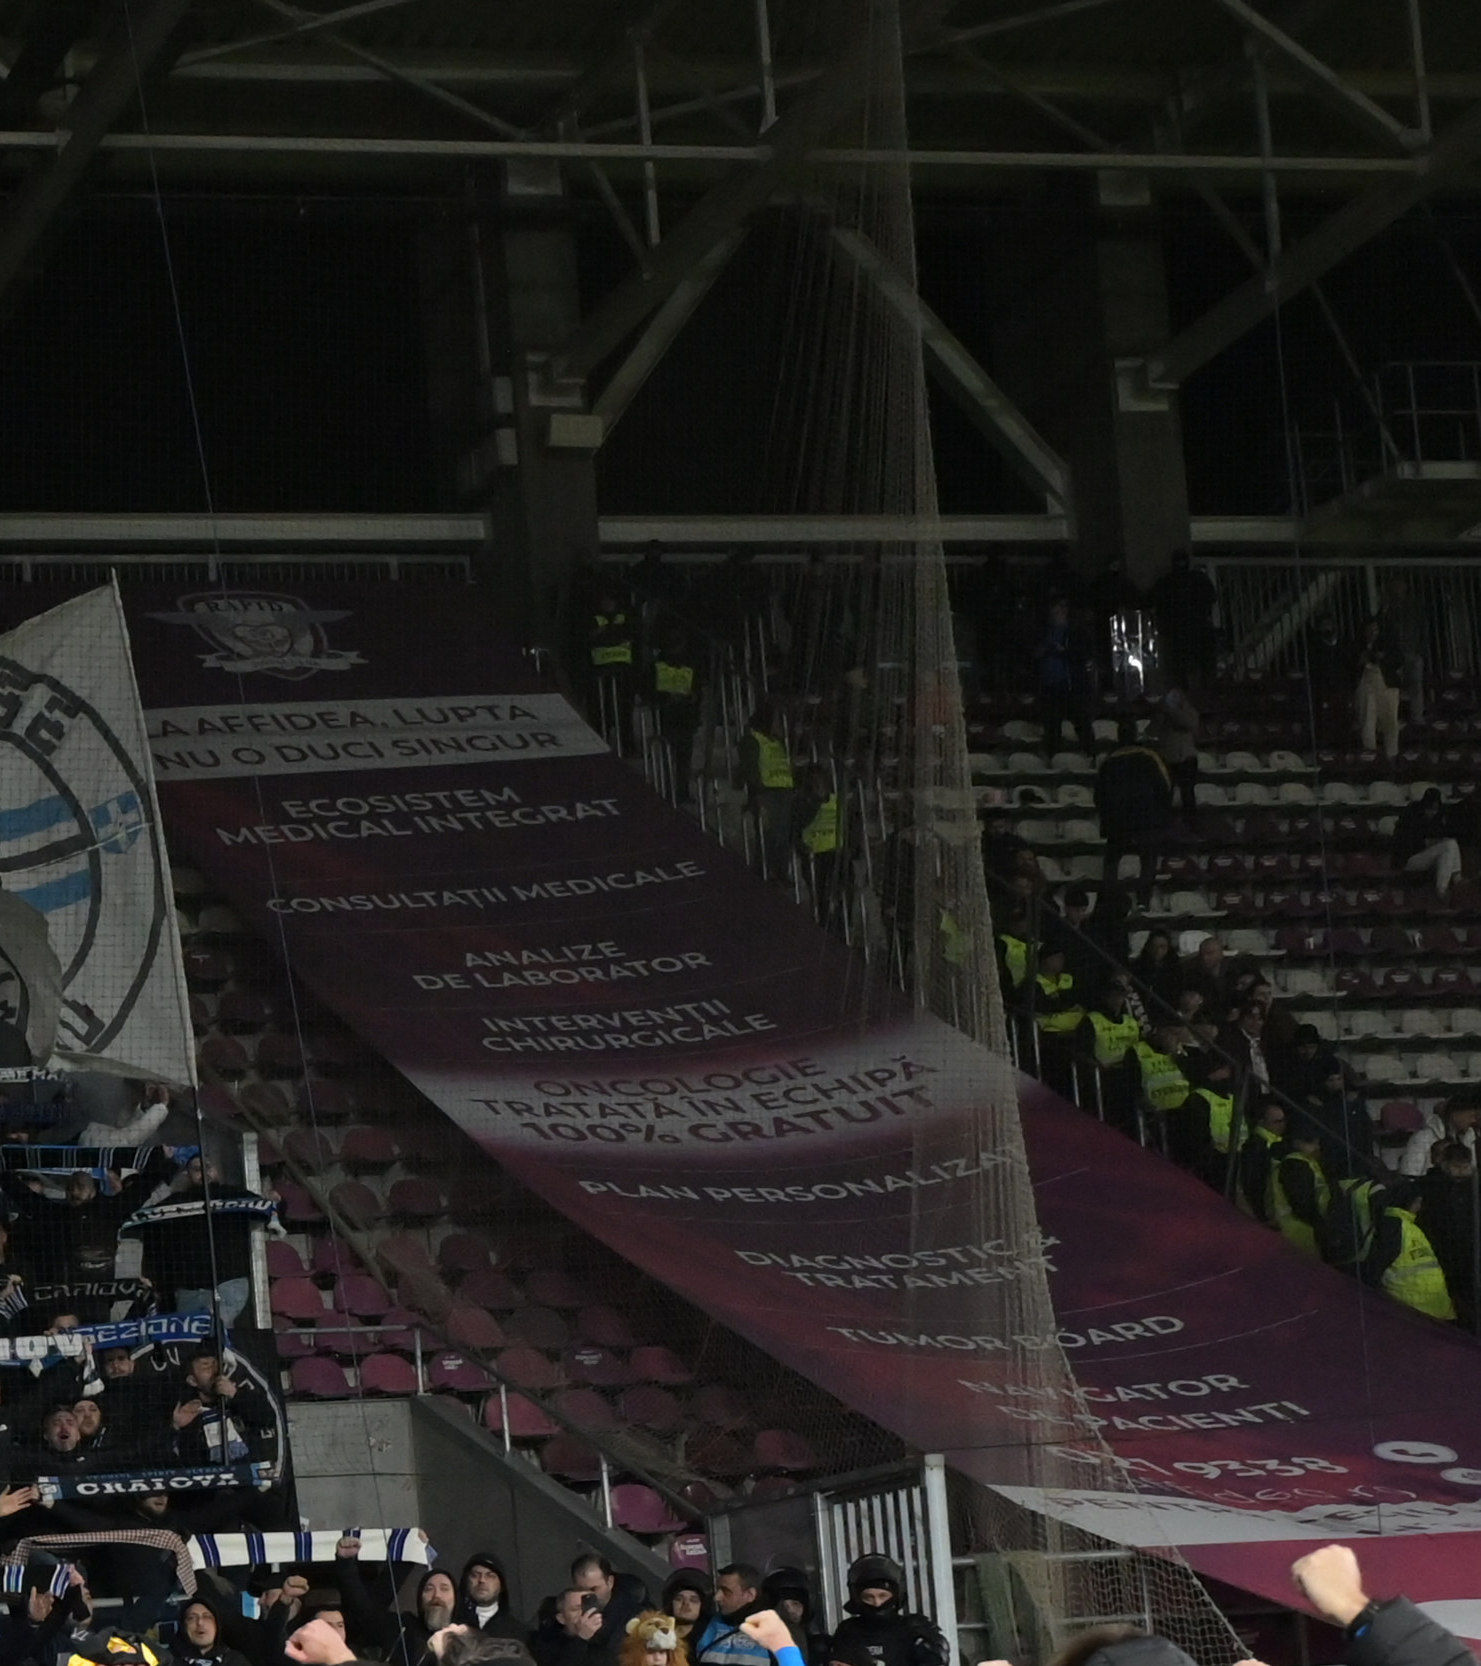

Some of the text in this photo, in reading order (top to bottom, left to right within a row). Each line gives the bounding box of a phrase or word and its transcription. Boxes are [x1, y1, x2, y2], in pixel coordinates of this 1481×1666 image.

[391, 703, 539, 728] LUPTA
[155, 731, 561, 773] NU O DUCI SINGUR
[216, 797, 626, 848] MEDICAL INTEGRAT
[282, 786, 523, 819] ECOSISTEM
[511, 859, 707, 903] MEDICALE
[412, 951, 712, 992] DE LABORATOR
[464, 940, 628, 970] ANALIZE
[481, 1013, 778, 1054] CHIRURGICALE
[533, 1057, 826, 1101] ONCOLOGIE
[750, 1055, 939, 1115] ECHIPĂ
[523, 1084, 936, 1145] 100% GRATUIT
[578, 1178, 701, 1201] PLAN
[734, 1238, 1009, 1274] DIAGNOSTIC
[826, 1314, 1186, 1351] TUMOR BOARD
[75, 1473, 241, 1497] CRAIOVA
